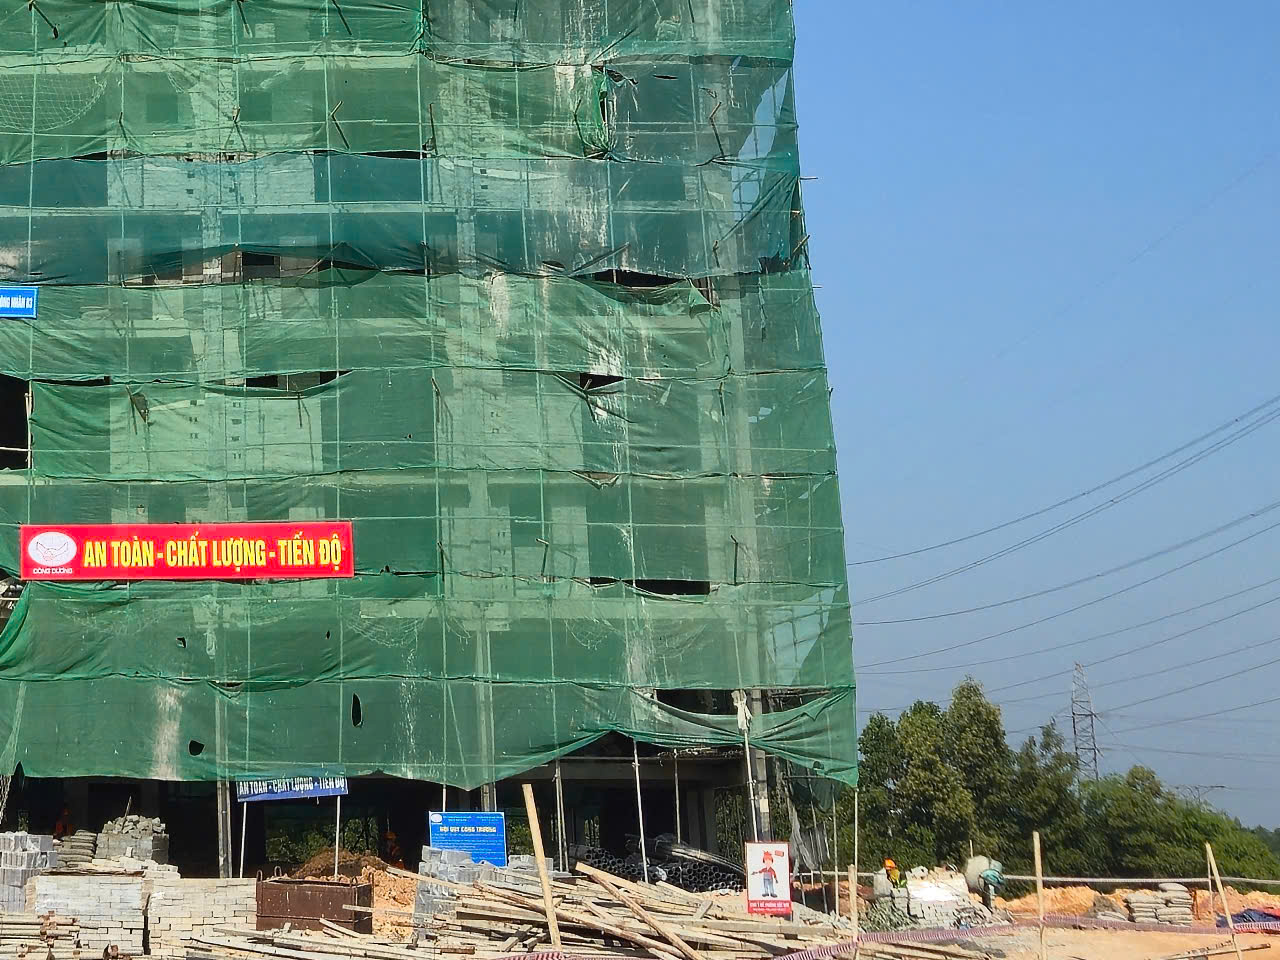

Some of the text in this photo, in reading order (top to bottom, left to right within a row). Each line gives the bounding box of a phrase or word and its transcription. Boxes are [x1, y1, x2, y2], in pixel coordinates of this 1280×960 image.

[84, 541, 107, 567] AN
[111, 536, 154, 567] TOÀN
[166, 531, 208, 567] CHẤT
[213, 537, 266, 572] LƯỢNG
[278, 531, 315, 566] TIẾN
[319, 534, 342, 571] ĐỘ
